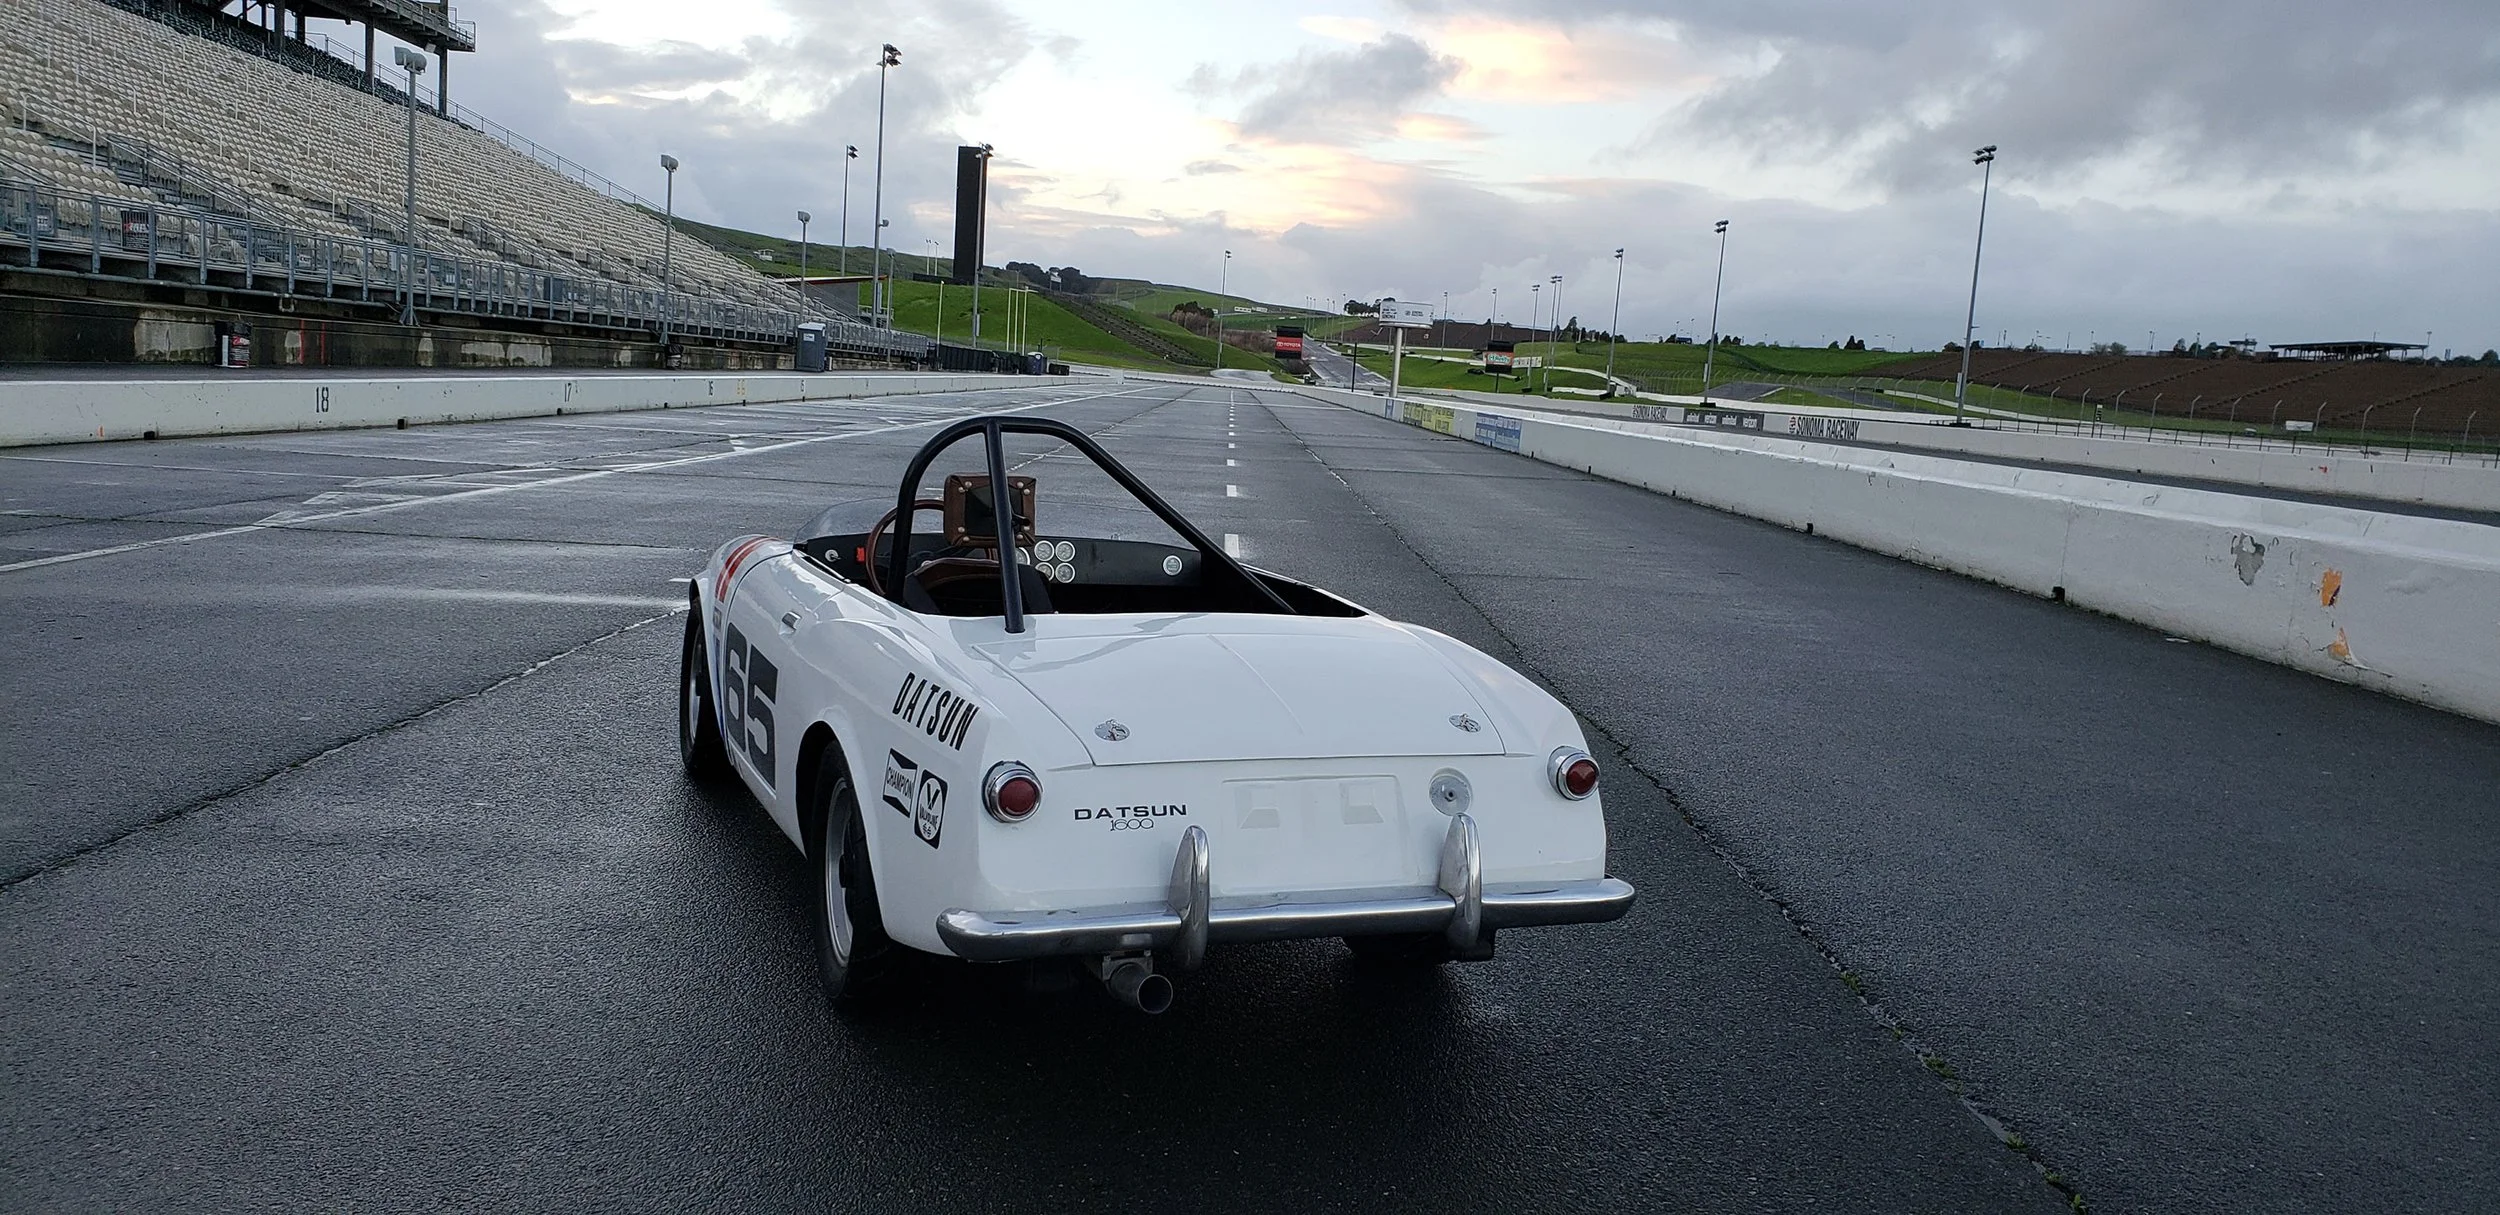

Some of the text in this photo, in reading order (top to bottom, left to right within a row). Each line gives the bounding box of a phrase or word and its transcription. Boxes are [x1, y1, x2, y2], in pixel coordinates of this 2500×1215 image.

[316, 386, 329, 413] 18
[565, 382, 572, 402] 17
[1797, 416, 1860, 441] SONOMA RACEWAY
[725, 622, 778, 791] 65
[892, 672, 980, 751] DATSUN
[1074, 804, 1187, 820] DATSUN
[1110, 818, 1154, 831] 1600
